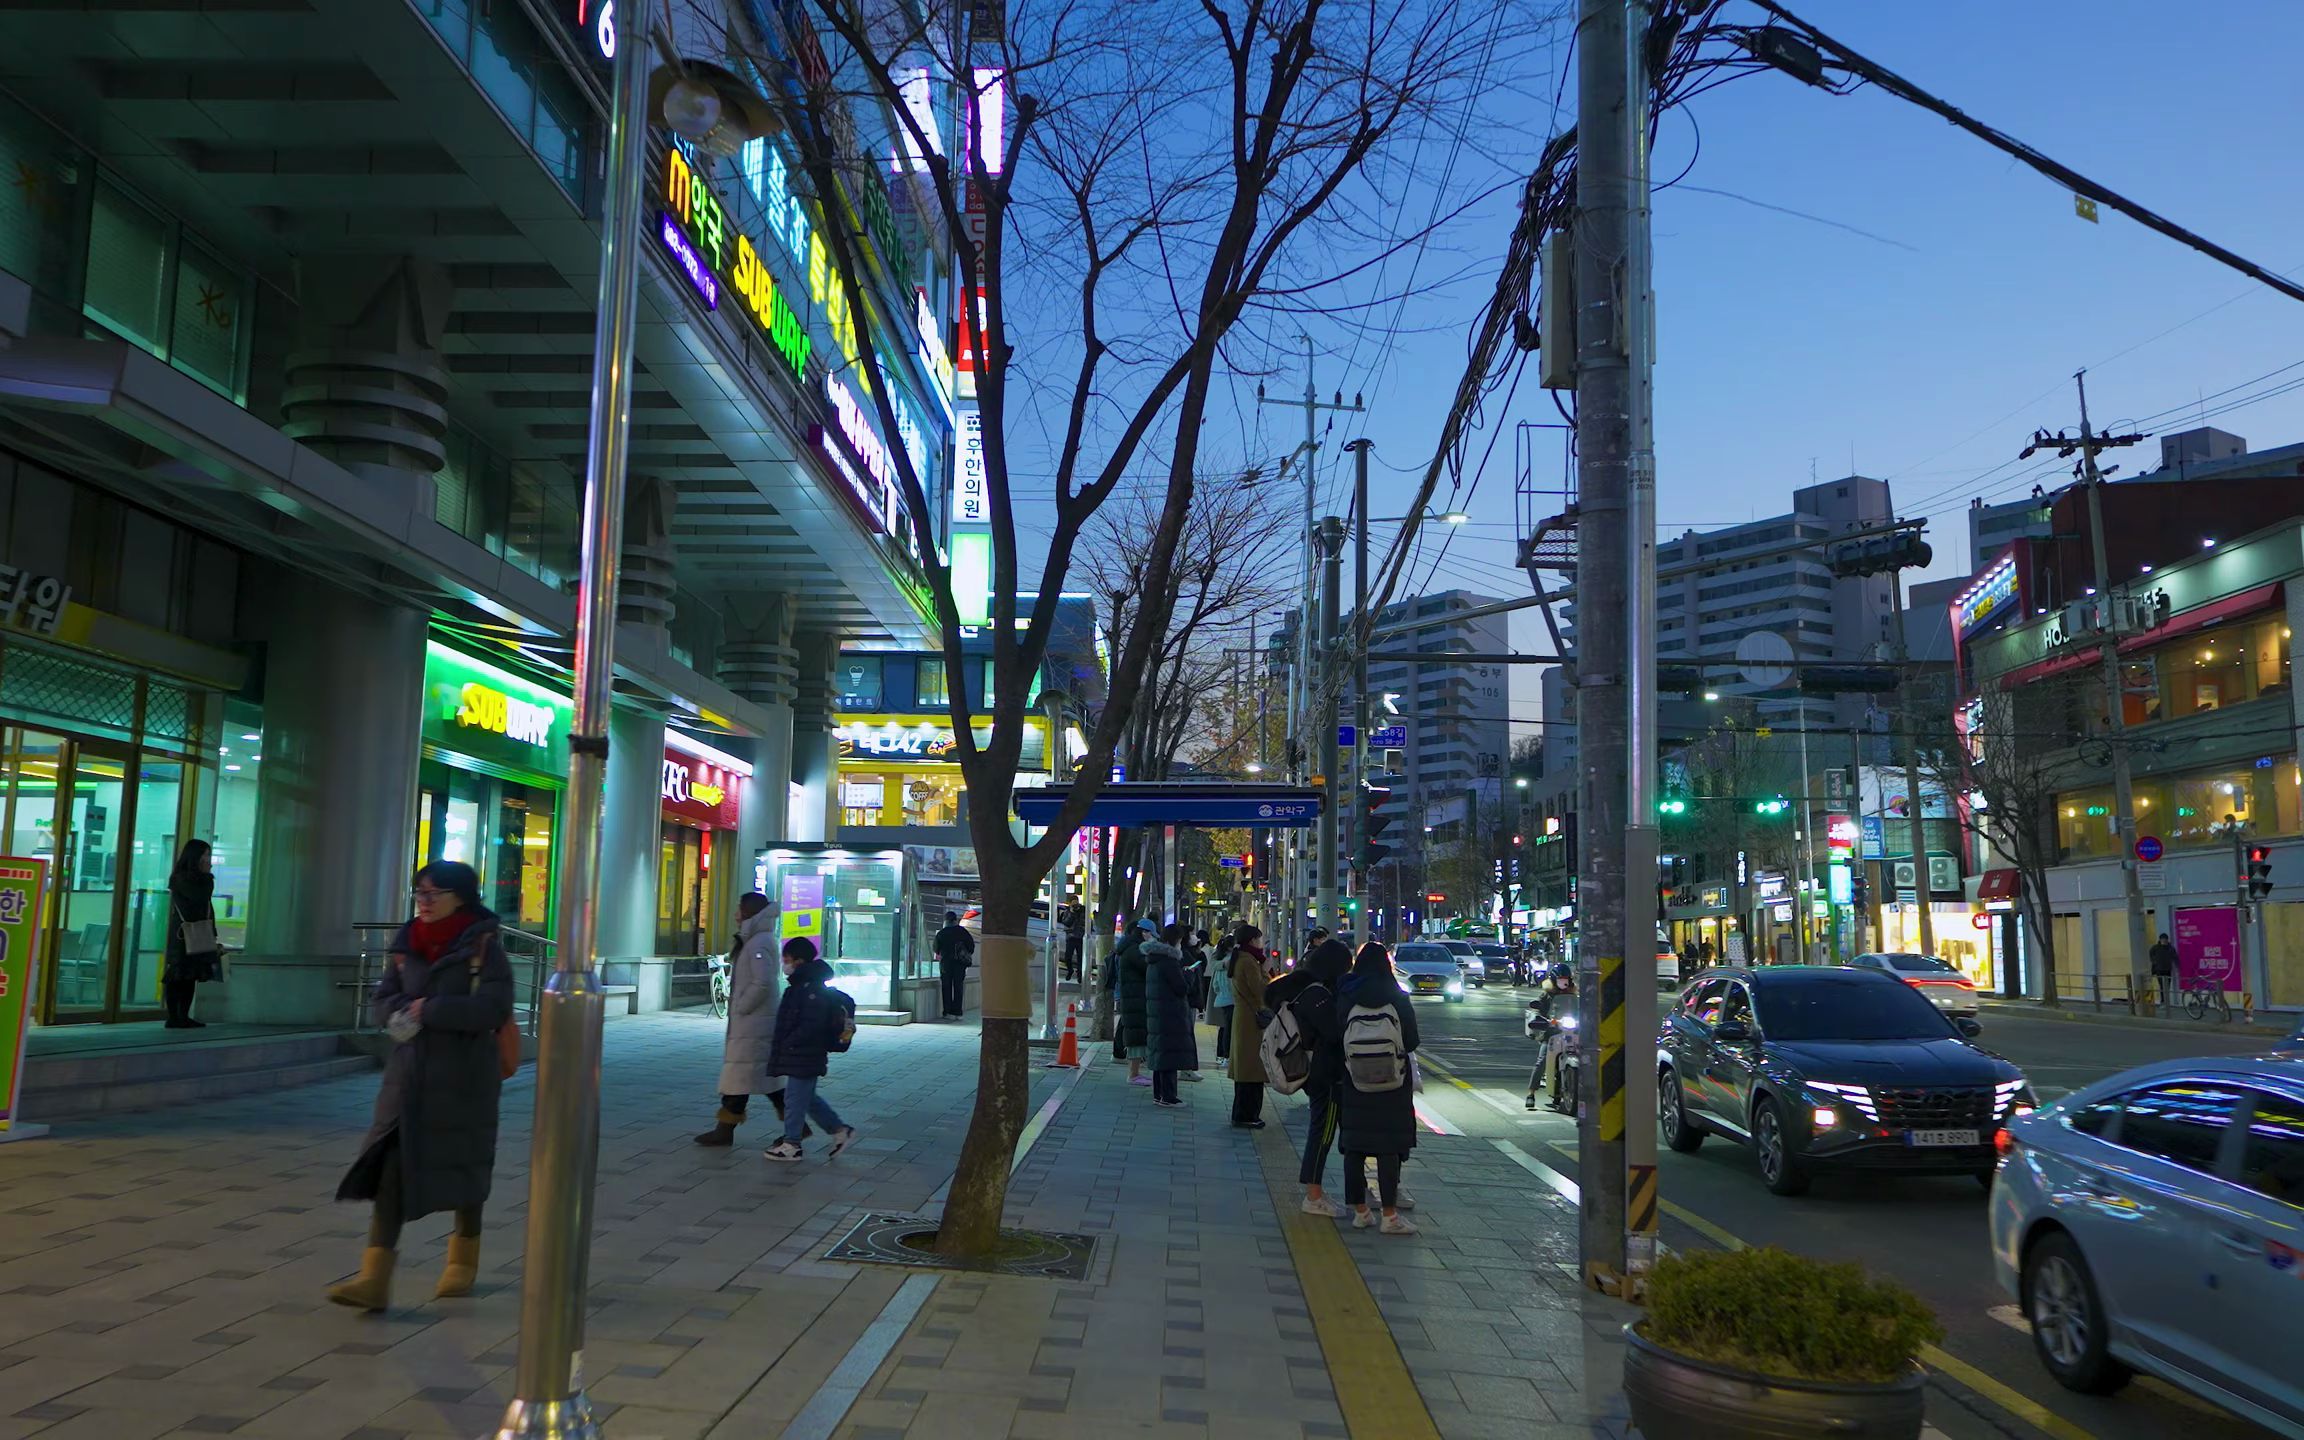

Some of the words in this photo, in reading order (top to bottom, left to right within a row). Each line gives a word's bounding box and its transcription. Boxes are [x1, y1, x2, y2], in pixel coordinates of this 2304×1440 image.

[733, 233, 811, 381] SUBWAY
[460, 682, 555, 748] SUBWAY
[1275, 804, 1306, 817] 관악구
